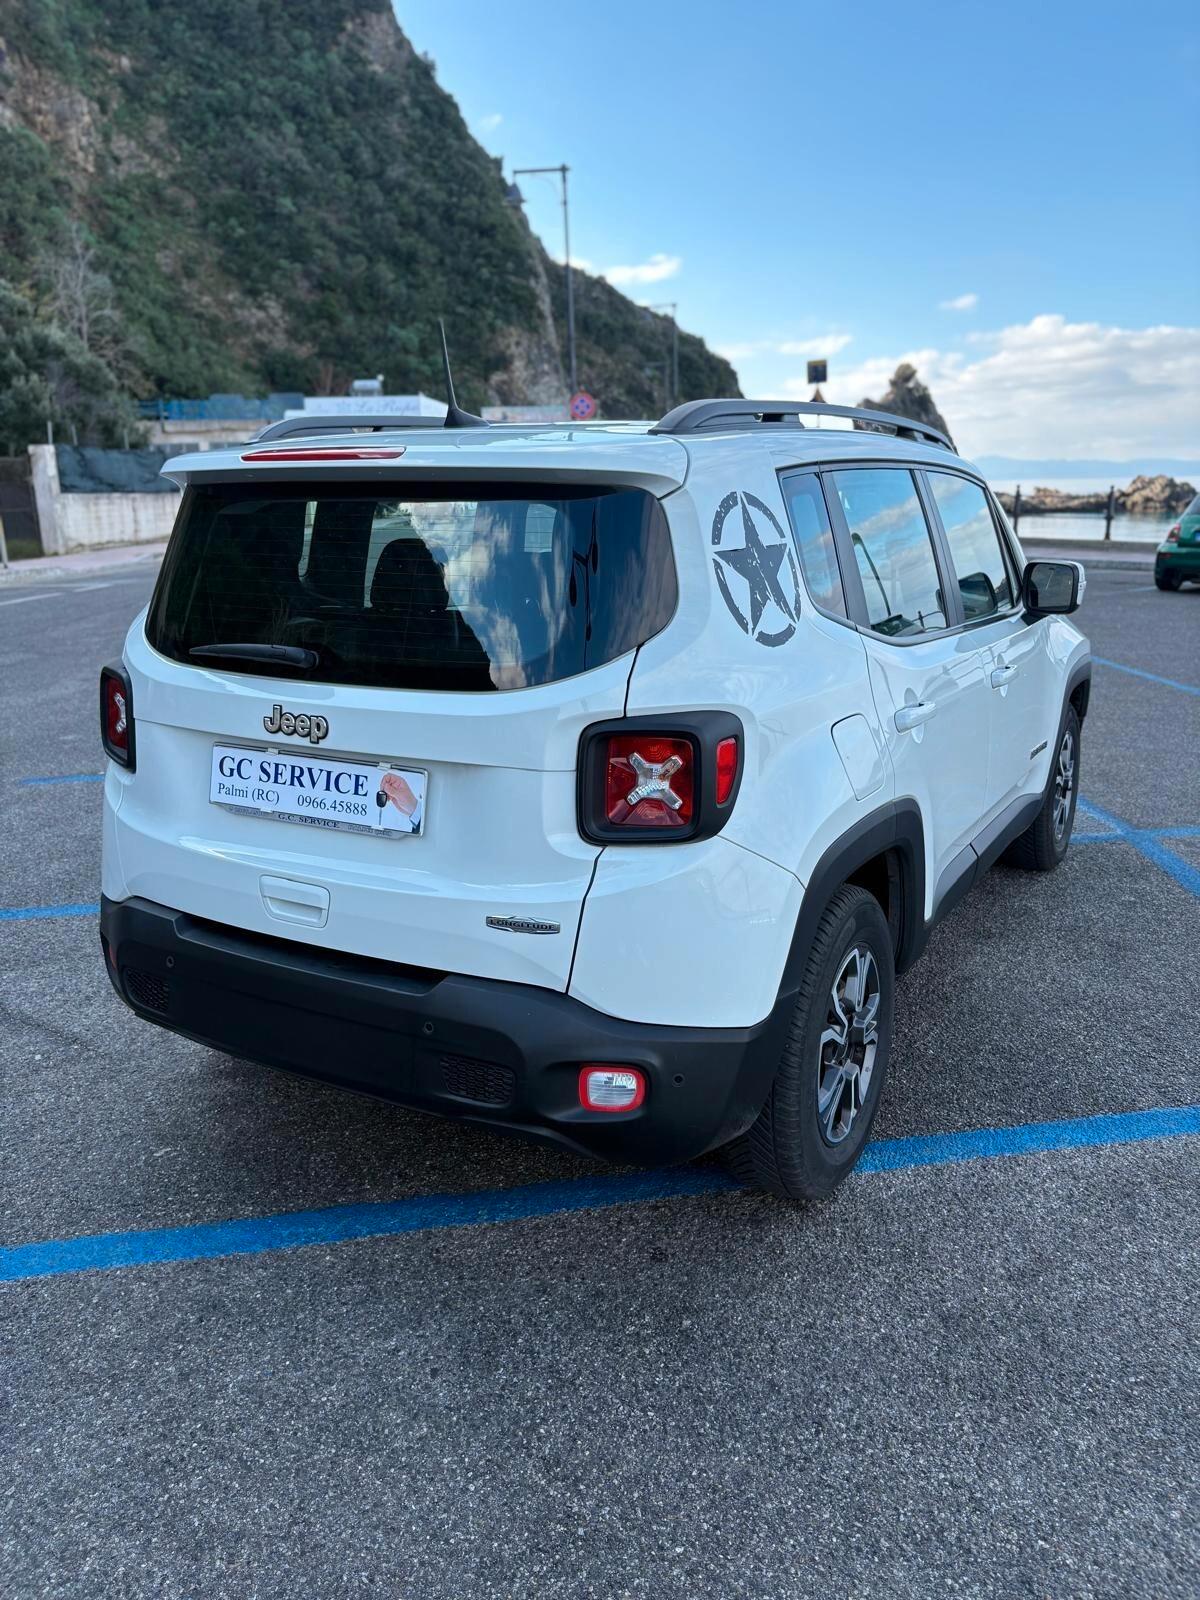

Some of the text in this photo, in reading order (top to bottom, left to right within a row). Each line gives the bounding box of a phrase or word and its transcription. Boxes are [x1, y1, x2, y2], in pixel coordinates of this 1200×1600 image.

[263, 704, 329, 744] Jeep
[219, 755, 369, 797] GC SERVICE
[218, 782, 368, 817] Palmi (RC) 0966.45888
[278, 813, 340, 829] G.C. SERVICE
[490, 918, 556, 931] LONGITUDE
